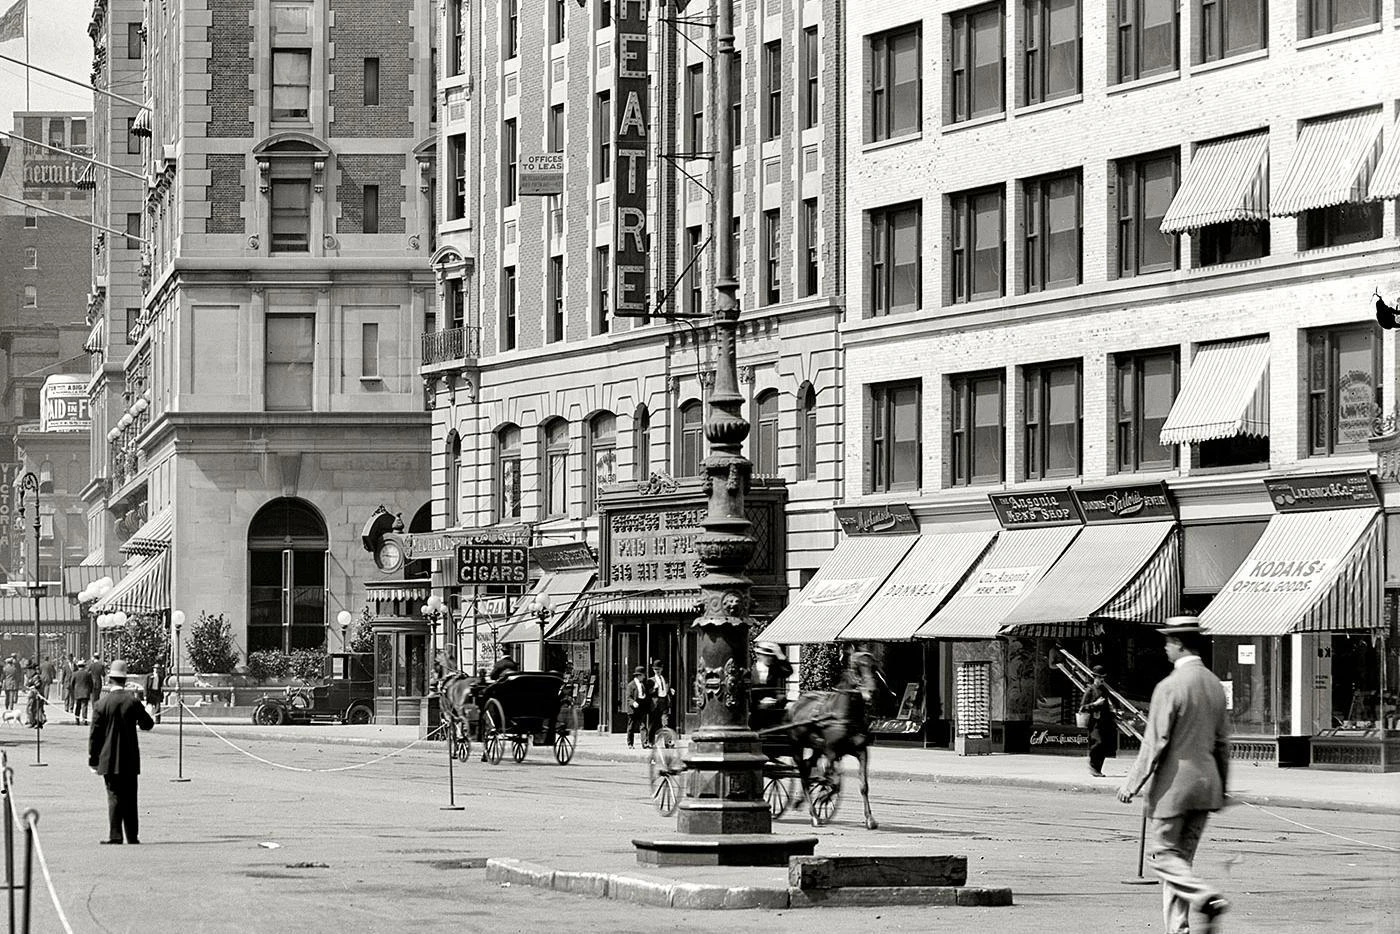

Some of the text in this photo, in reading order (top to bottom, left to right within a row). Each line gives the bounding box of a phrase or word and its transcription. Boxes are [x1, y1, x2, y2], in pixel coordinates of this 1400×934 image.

[0, 463, 10, 546] VICTORIA
[461, 549, 524, 565] UNITED
[460, 566, 525, 582] CIGARS
[1249, 560, 1321, 578] KODAKS
